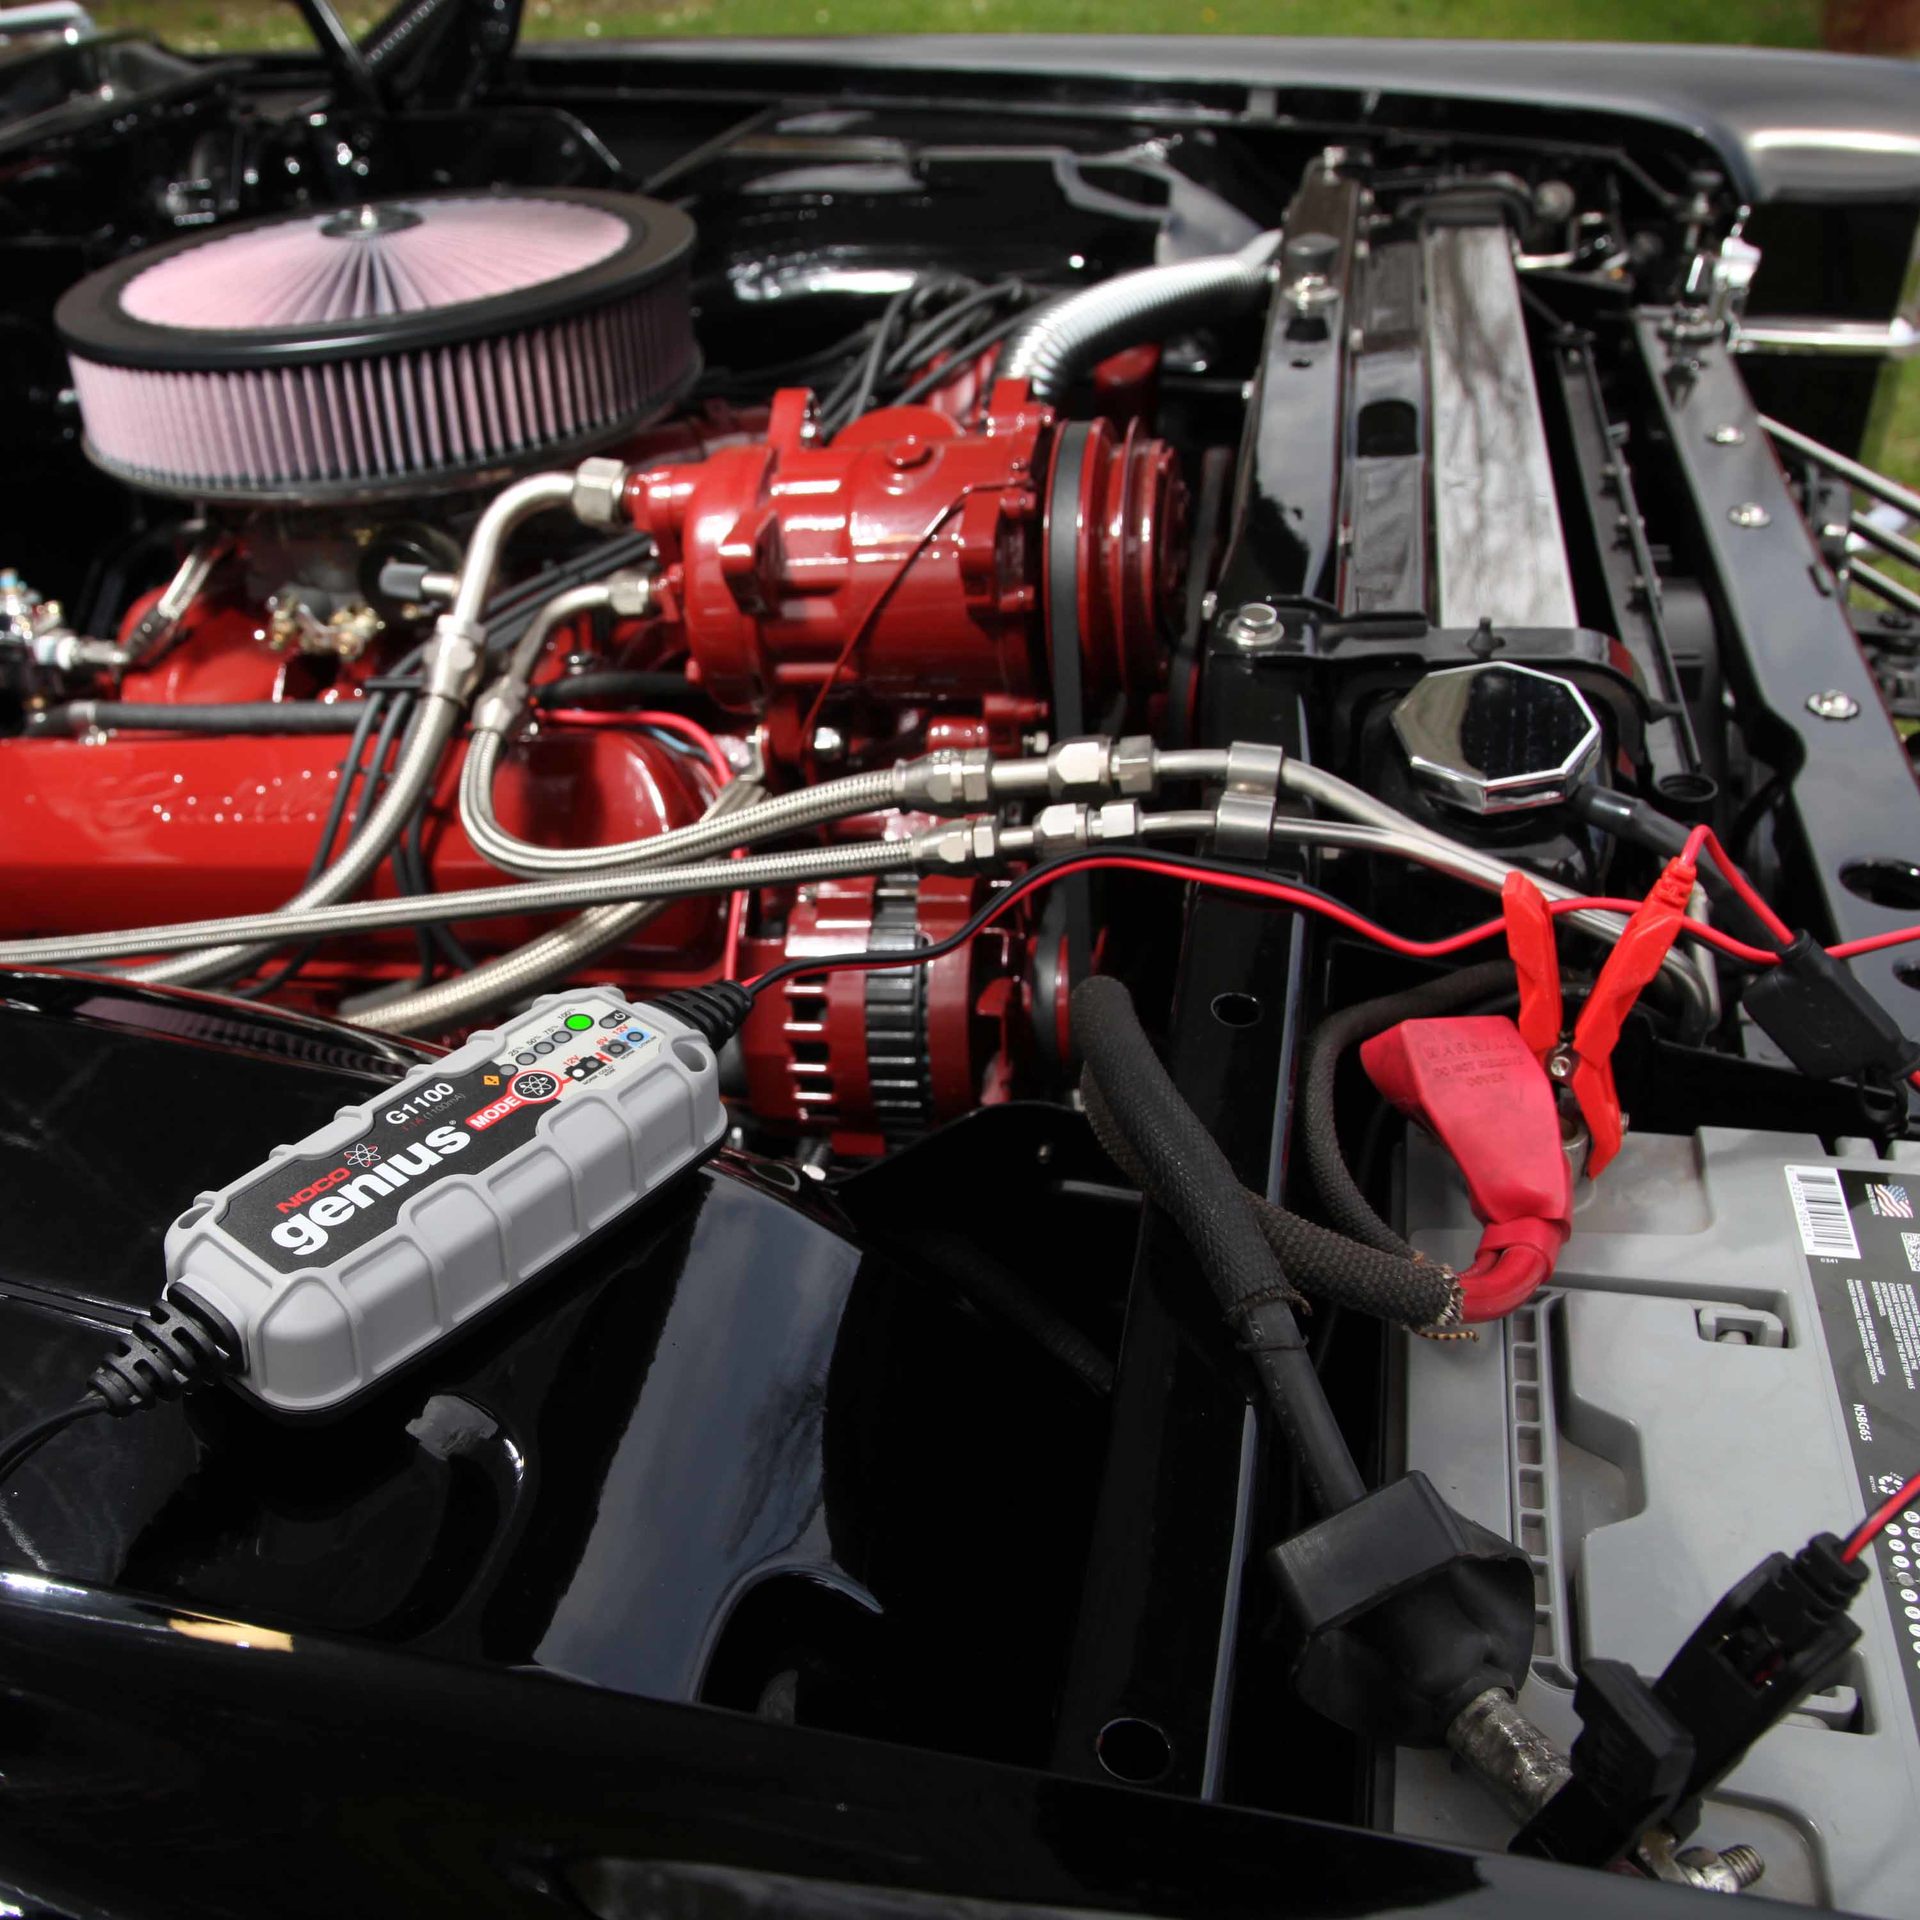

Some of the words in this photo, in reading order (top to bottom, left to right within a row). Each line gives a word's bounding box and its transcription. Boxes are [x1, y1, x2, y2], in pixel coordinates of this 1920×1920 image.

[596, 1036, 611, 1047] 6V
[612, 1023, 630, 1036] 12V
[563, 1055, 581, 1067] 12V
[385, 1082, 454, 1125] G1100
[469, 1095, 522, 1129] MODE
[270, 1125, 471, 1256] genius
[276, 1167, 352, 1214] NOCO
[1853, 1404, 1873, 1441] NSBG65
